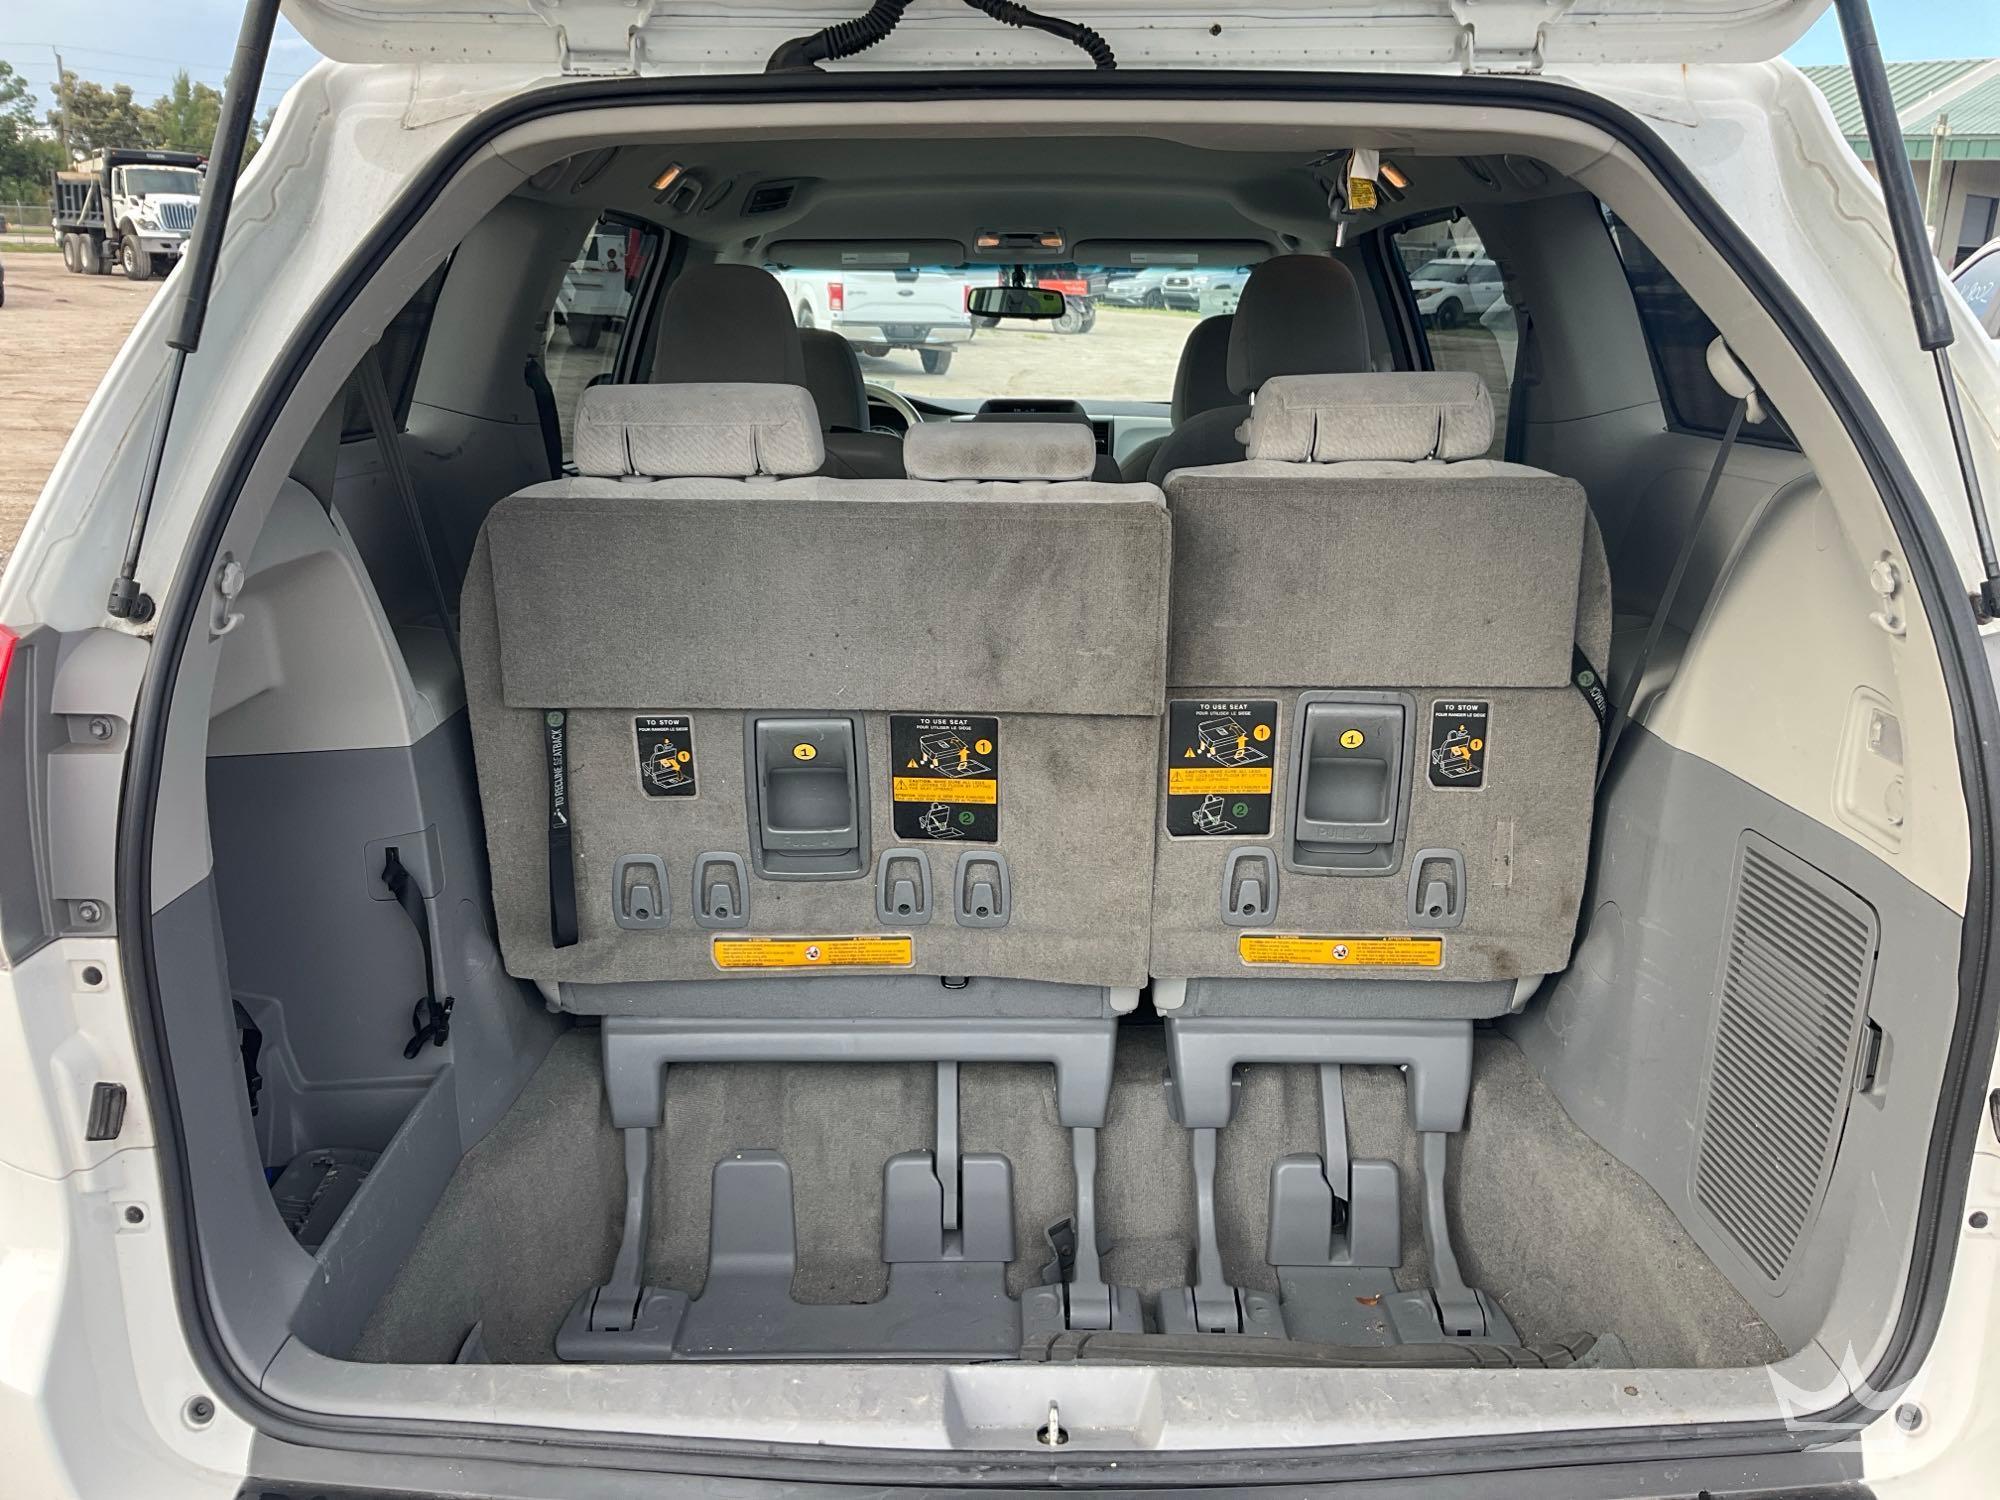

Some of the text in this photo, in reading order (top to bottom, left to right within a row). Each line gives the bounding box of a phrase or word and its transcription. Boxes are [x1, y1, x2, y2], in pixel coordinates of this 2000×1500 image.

[551, 728, 565, 808] TO RECLINE SEATBACK
